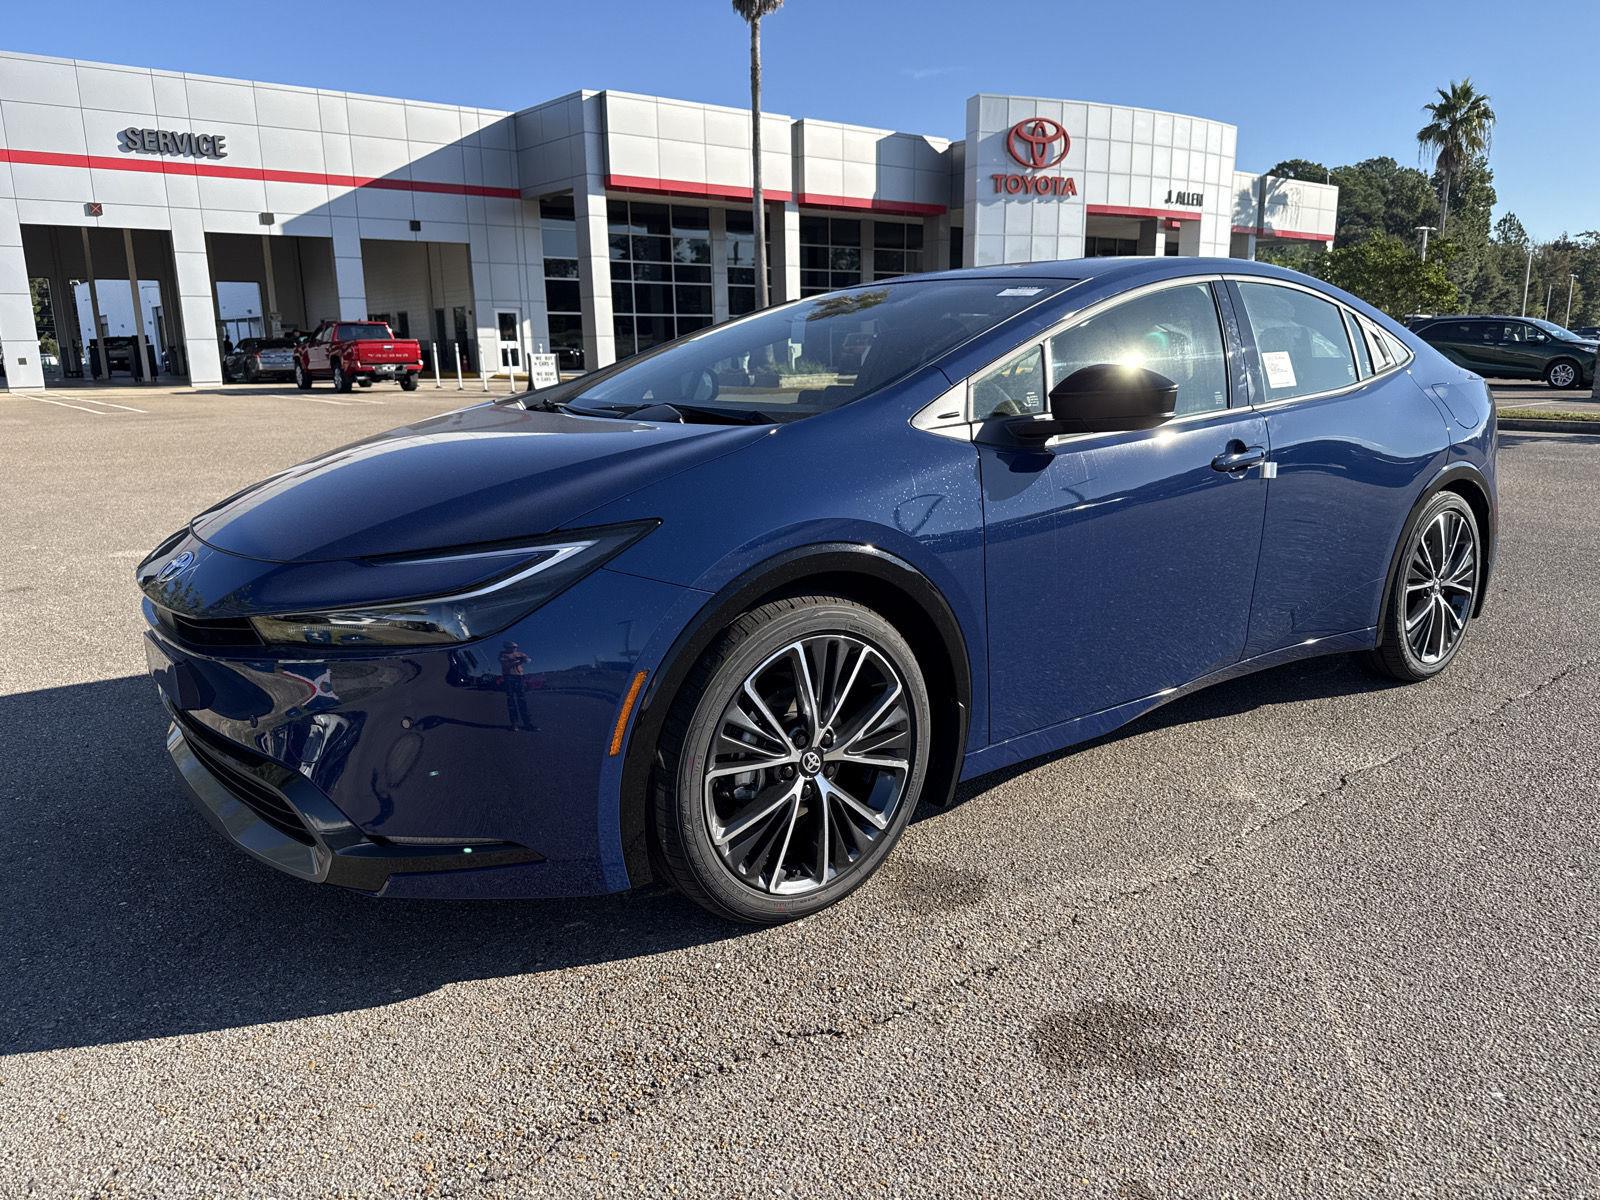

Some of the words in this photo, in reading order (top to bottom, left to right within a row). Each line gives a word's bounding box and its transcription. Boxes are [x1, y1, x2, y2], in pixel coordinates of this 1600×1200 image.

[122, 127, 227, 157] SERVICE
[992, 174, 1077, 196] TOYOTA
[1164, 190, 1174, 204] J.
[1175, 191, 1203, 207] ALLEN
